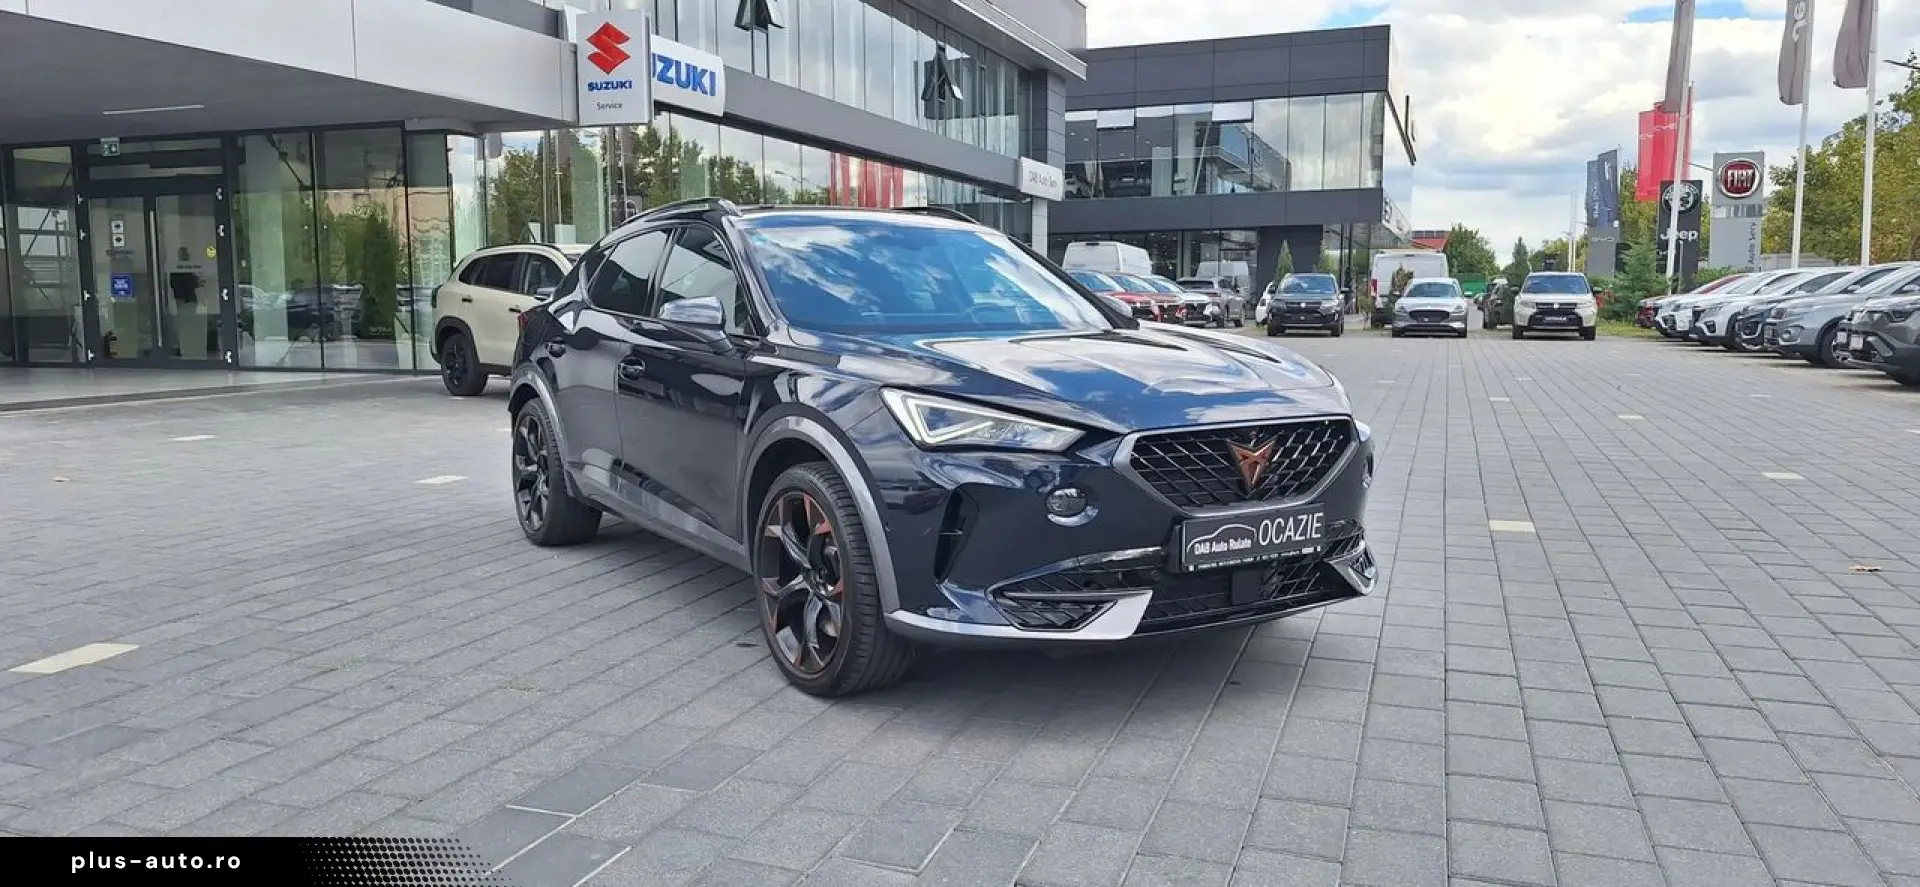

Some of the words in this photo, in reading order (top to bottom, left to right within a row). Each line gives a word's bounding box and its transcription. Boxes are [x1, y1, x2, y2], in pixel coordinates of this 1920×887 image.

[587, 80, 633, 92] SUZUKI
[596, 101, 623, 110] Service
[1727, 169, 1754, 188] FIAT
[1660, 228, 1699, 242] Jep
[1259, 512, 1324, 546] OCAZIE
[1194, 541, 1210, 555] DAB
[1211, 540, 1228, 553] Auto
[1229, 537, 1252, 551] Rulate
